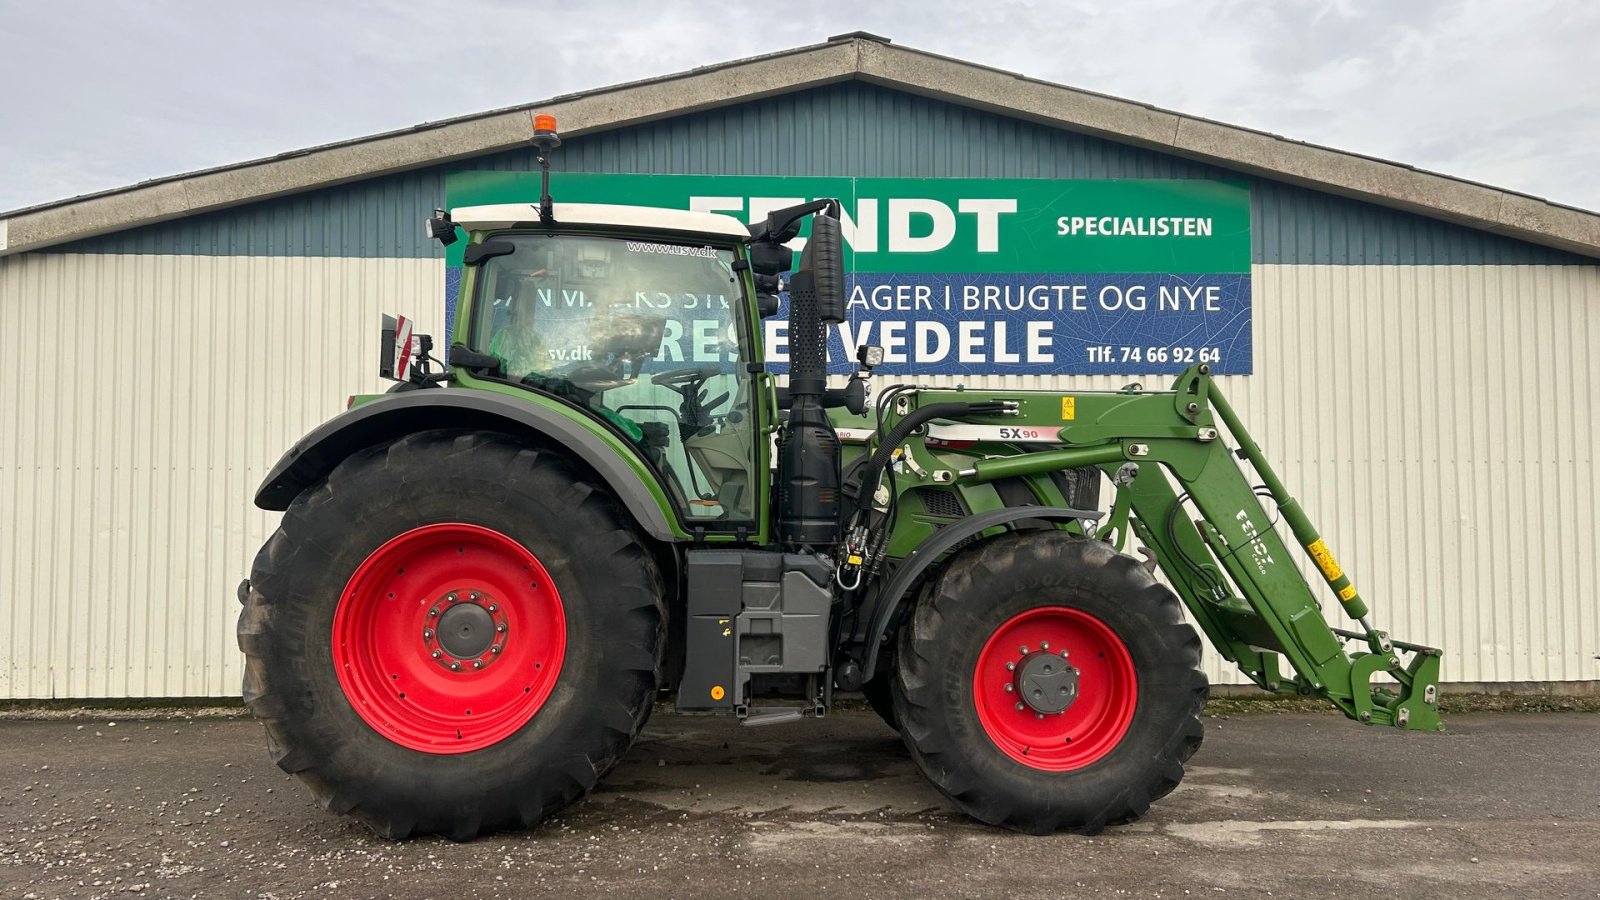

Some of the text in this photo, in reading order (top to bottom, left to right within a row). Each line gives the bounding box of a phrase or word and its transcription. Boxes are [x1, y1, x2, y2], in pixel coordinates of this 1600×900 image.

[1057, 216, 1212, 237] SPECIALISTEN
[626, 241, 718, 259] www.usv.dk
[846, 285, 932, 311] AGER
[944, 285, 951, 310] I
[963, 285, 1087, 311] BRUGTE
[1099, 286, 1147, 311] OG
[1159, 286, 1221, 312] NYE
[653, 319, 1055, 364] REEVEDELE
[549, 345, 592, 361] sv.dk
[1086, 346, 1221, 363] Tlf. 74 66 92 64
[1235, 509, 1274, 565] FENDT
